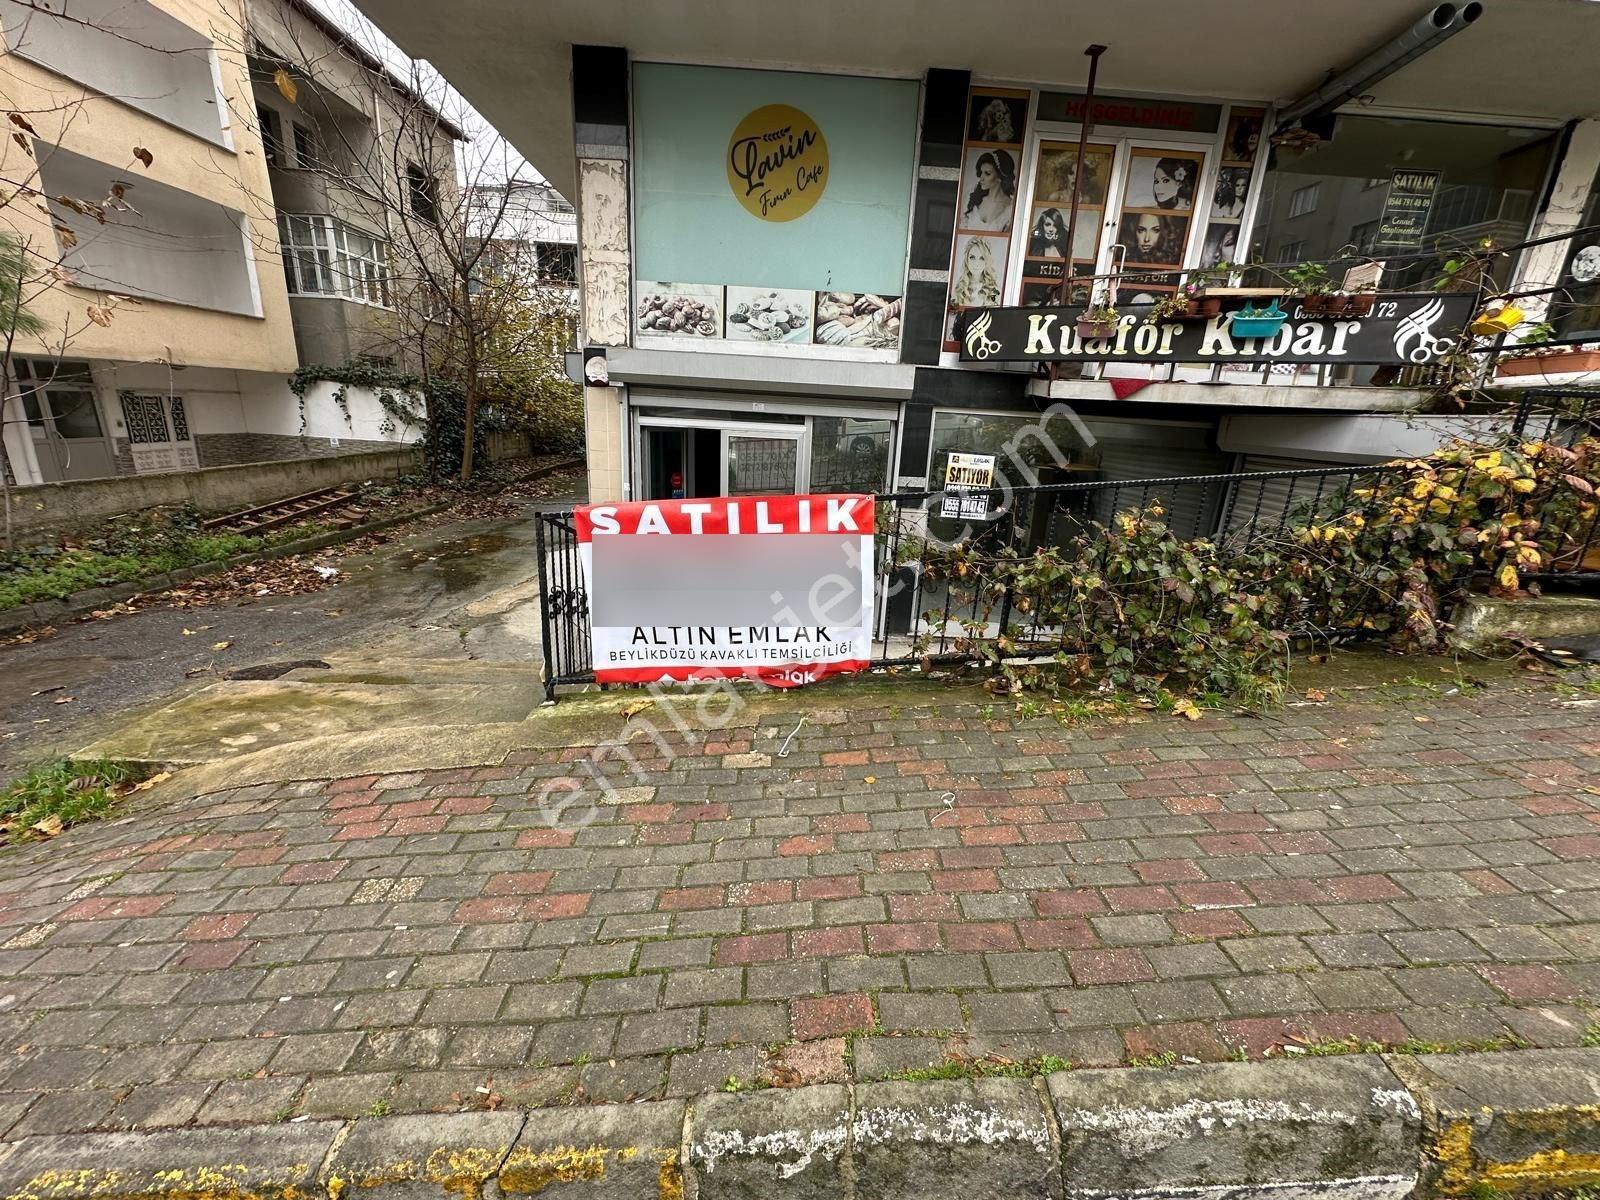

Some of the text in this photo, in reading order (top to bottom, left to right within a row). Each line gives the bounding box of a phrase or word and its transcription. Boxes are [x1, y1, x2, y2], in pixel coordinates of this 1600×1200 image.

[731, 130, 817, 197] Lavin
[797, 165, 824, 191] Cafe
[1393, 174, 1437, 190] SATILIK
[1376, 301, 1398, 318] 72
[1024, 314, 1184, 356] Kuaför
[949, 466, 990, 485] SATIYOR
[589, 498, 860, 535] SATILIK
[632, 626, 832, 645] ALTIN EMLAK
[609, 640, 853, 661] BEYLİKDÜZÜ KAVAKLI TEMSİLCİLİĞİ
